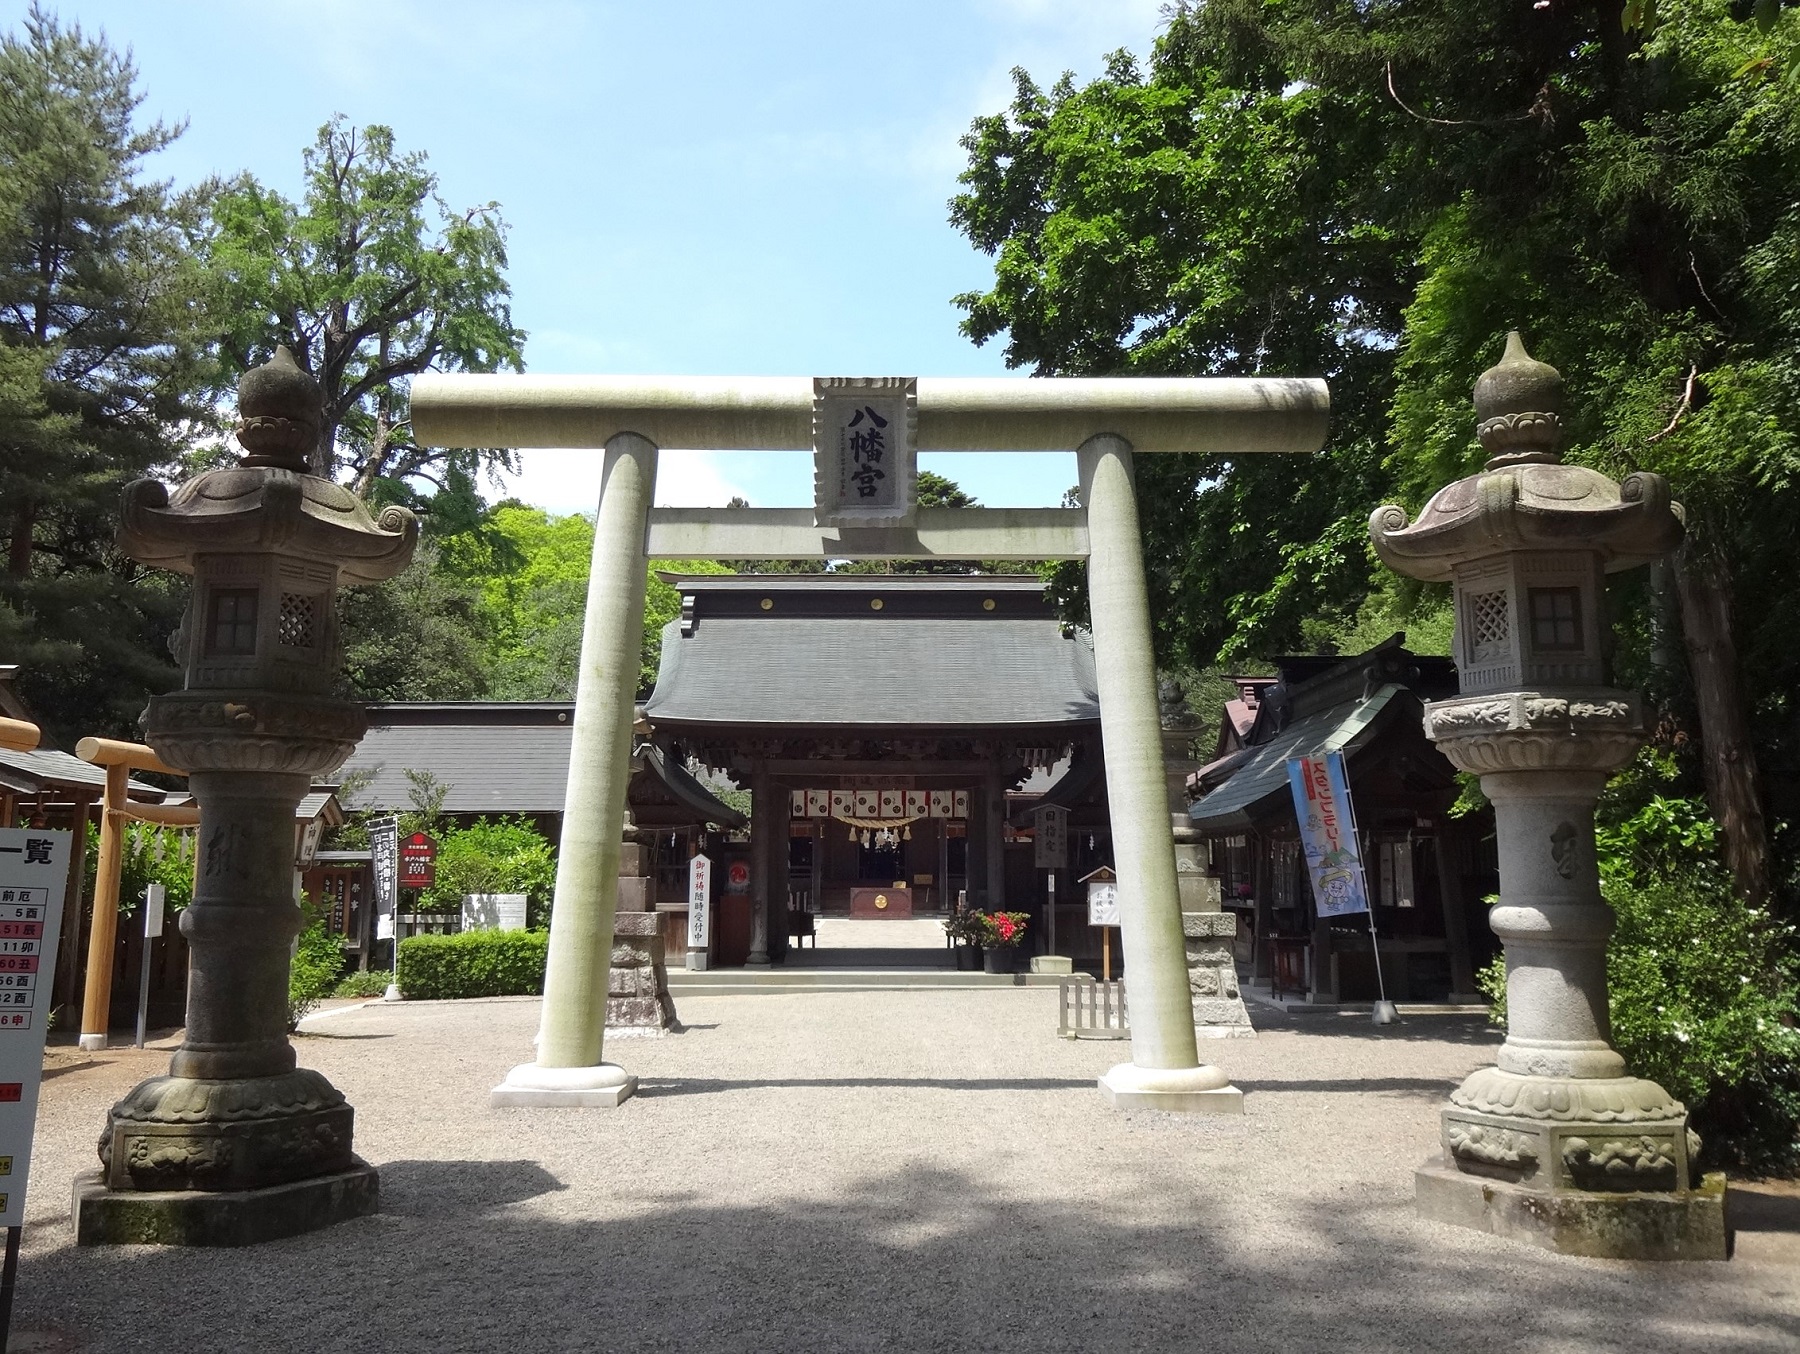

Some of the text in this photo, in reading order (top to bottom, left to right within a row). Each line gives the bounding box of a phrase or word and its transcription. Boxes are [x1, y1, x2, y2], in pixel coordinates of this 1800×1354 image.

[848, 405, 889, 498] 八幡宮
[2, 890, 31, 902] 前厄
[694, 860, 705, 942] 御祈祷随時受付中
[1107, 884, 1115, 907] 自動車
